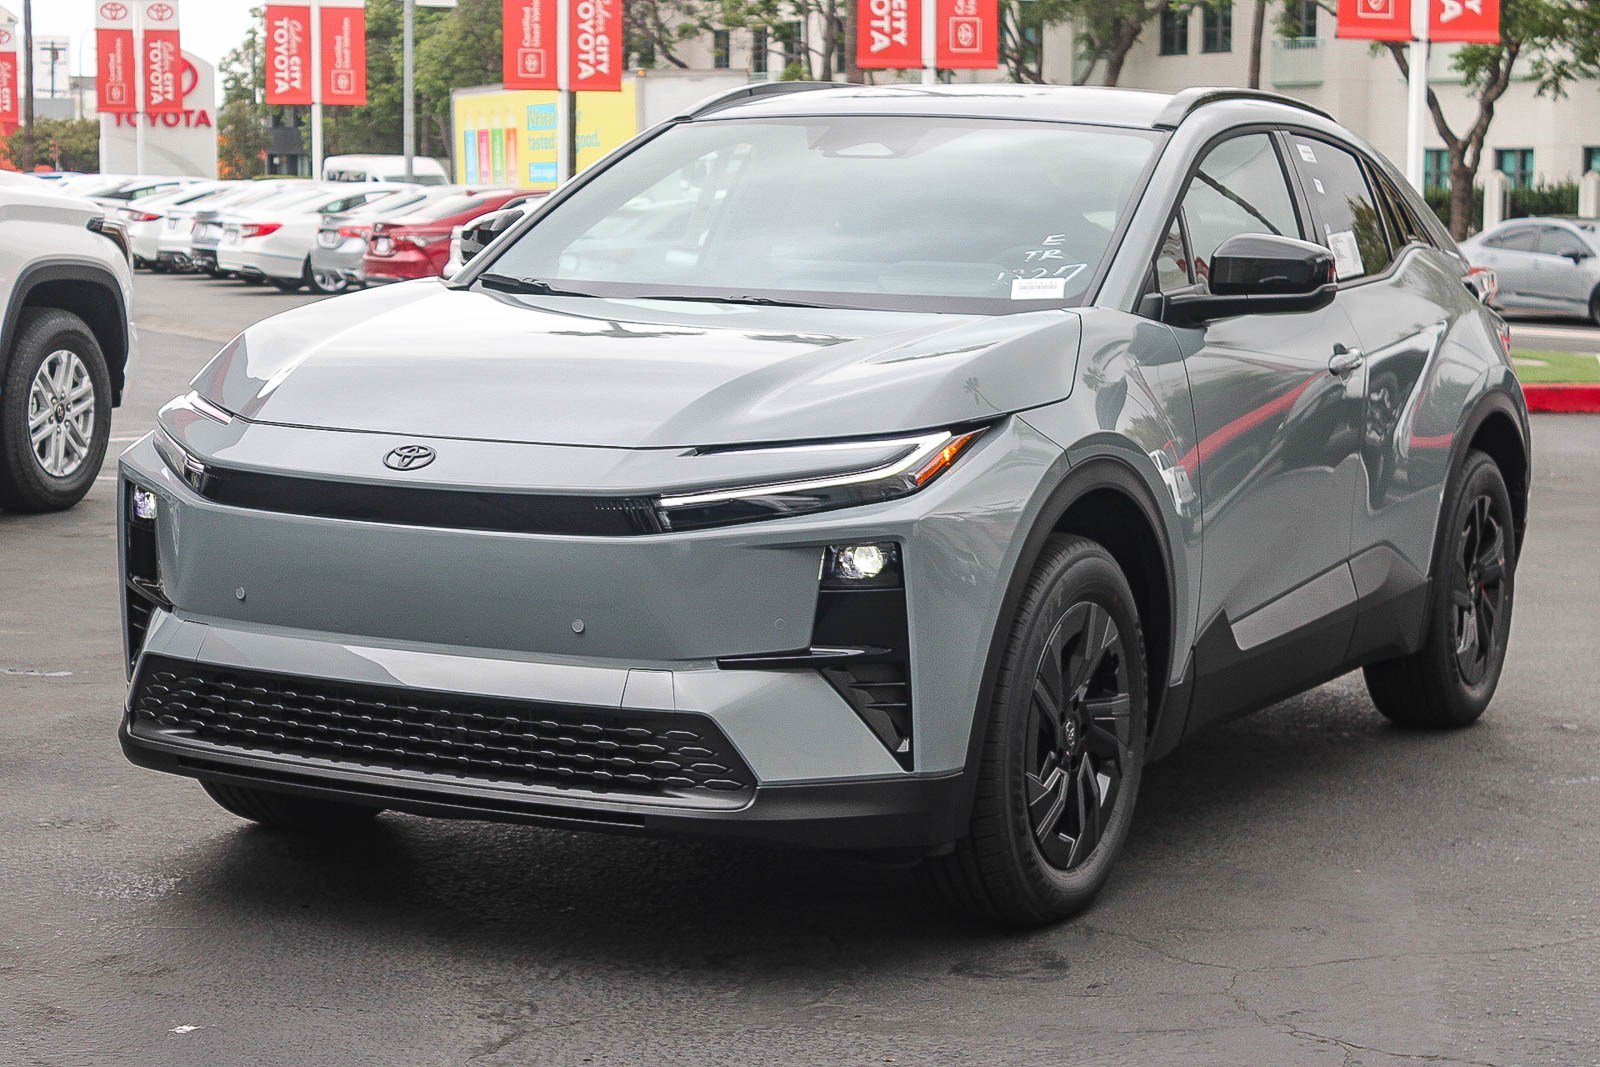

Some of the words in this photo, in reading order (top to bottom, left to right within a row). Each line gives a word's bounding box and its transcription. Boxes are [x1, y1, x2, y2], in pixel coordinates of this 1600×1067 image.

[577, 0, 596, 80] OYOTA
[870, 0, 891, 53] OTA
[149, 40, 163, 105] TOYOTA
[273, 17, 290, 94] TOYOTA
[289, 55, 302, 90] CITY
[595, 34, 610, 75] CITY
[163, 72, 174, 101] CITY
[115, 110, 212, 127] TOYOTA
[1024, 249, 1064, 262] TR
[1042, 234, 1066, 246] E
